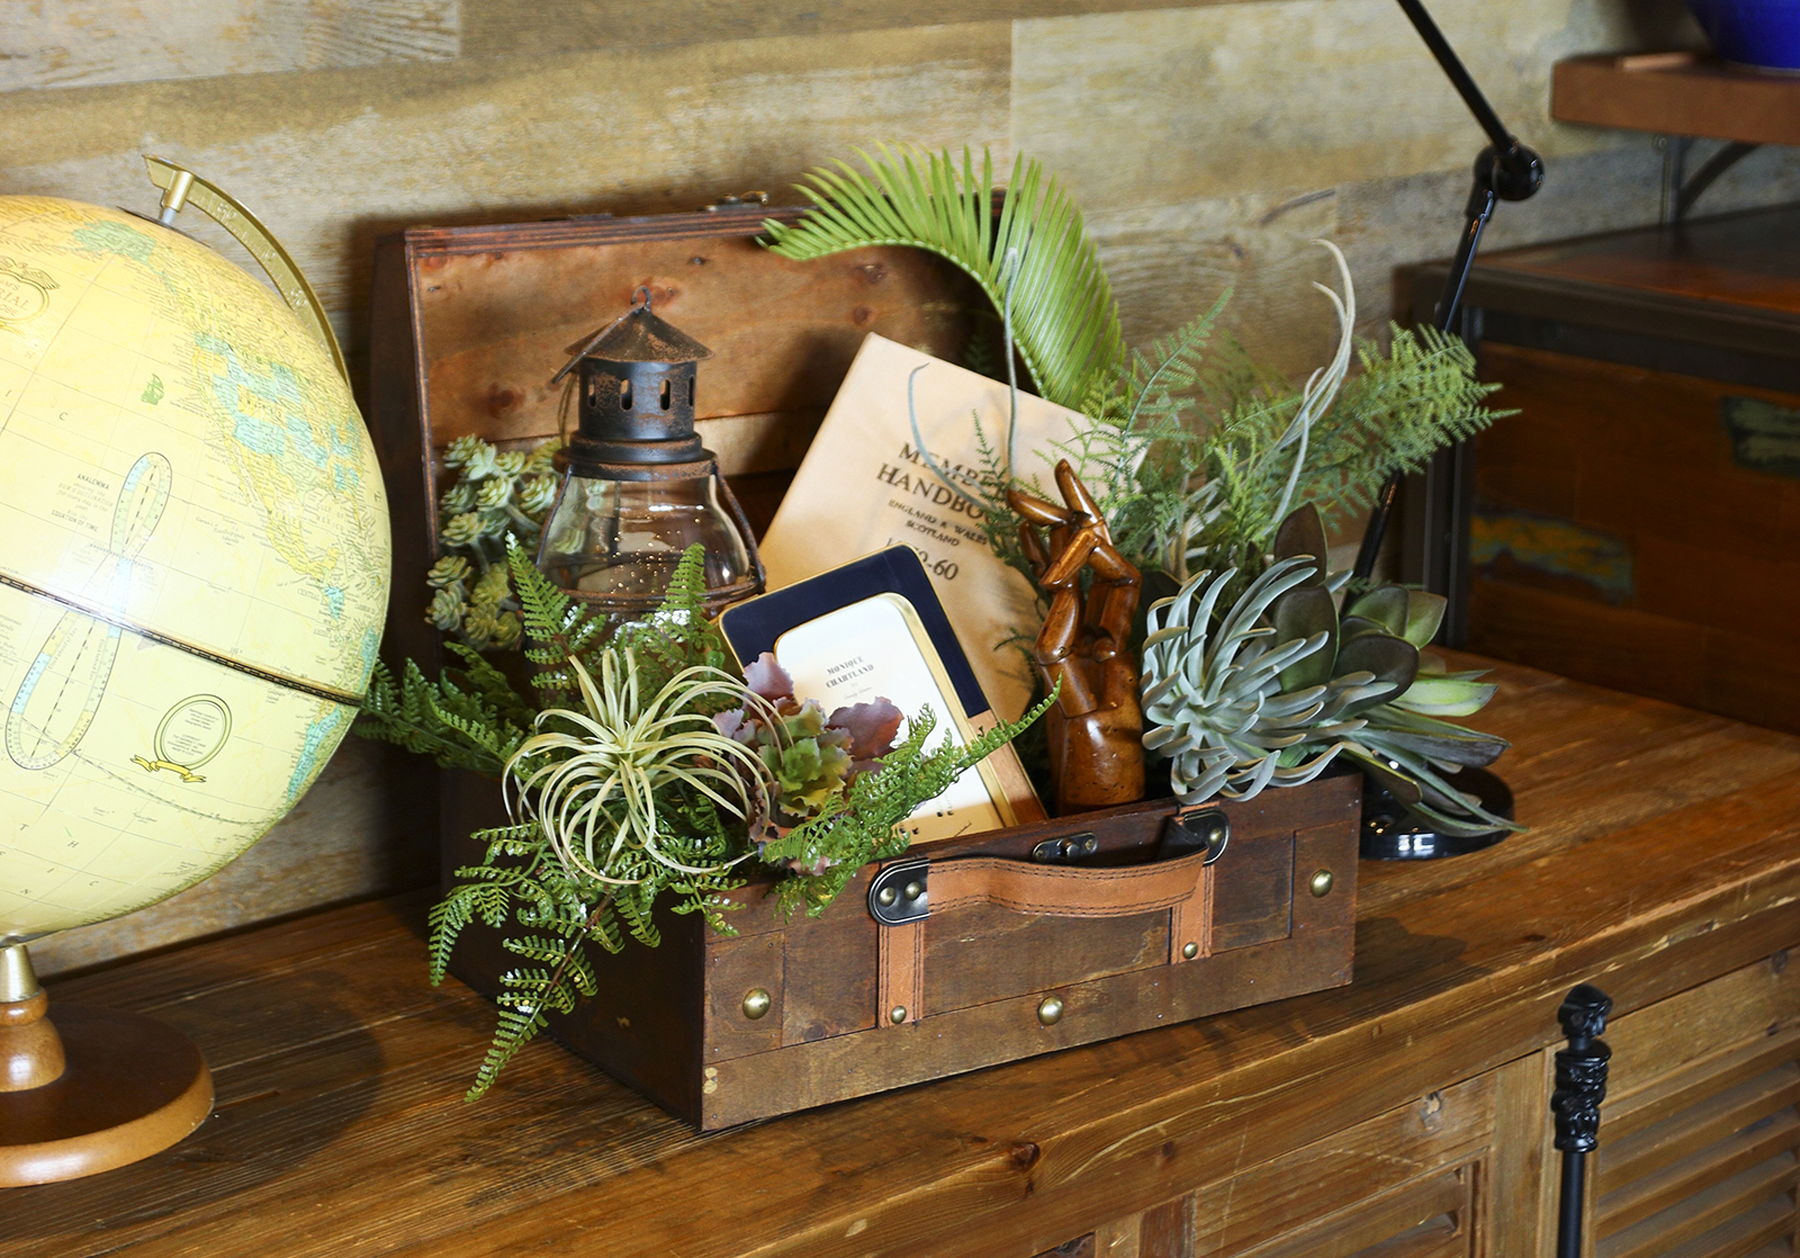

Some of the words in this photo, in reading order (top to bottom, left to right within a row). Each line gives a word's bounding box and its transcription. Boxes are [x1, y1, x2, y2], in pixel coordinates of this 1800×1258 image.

[888, 499, 937, 523] ENGLAND
[954, 524, 988, 546] WALES
[906, 519, 960, 546] SCOTLAND
